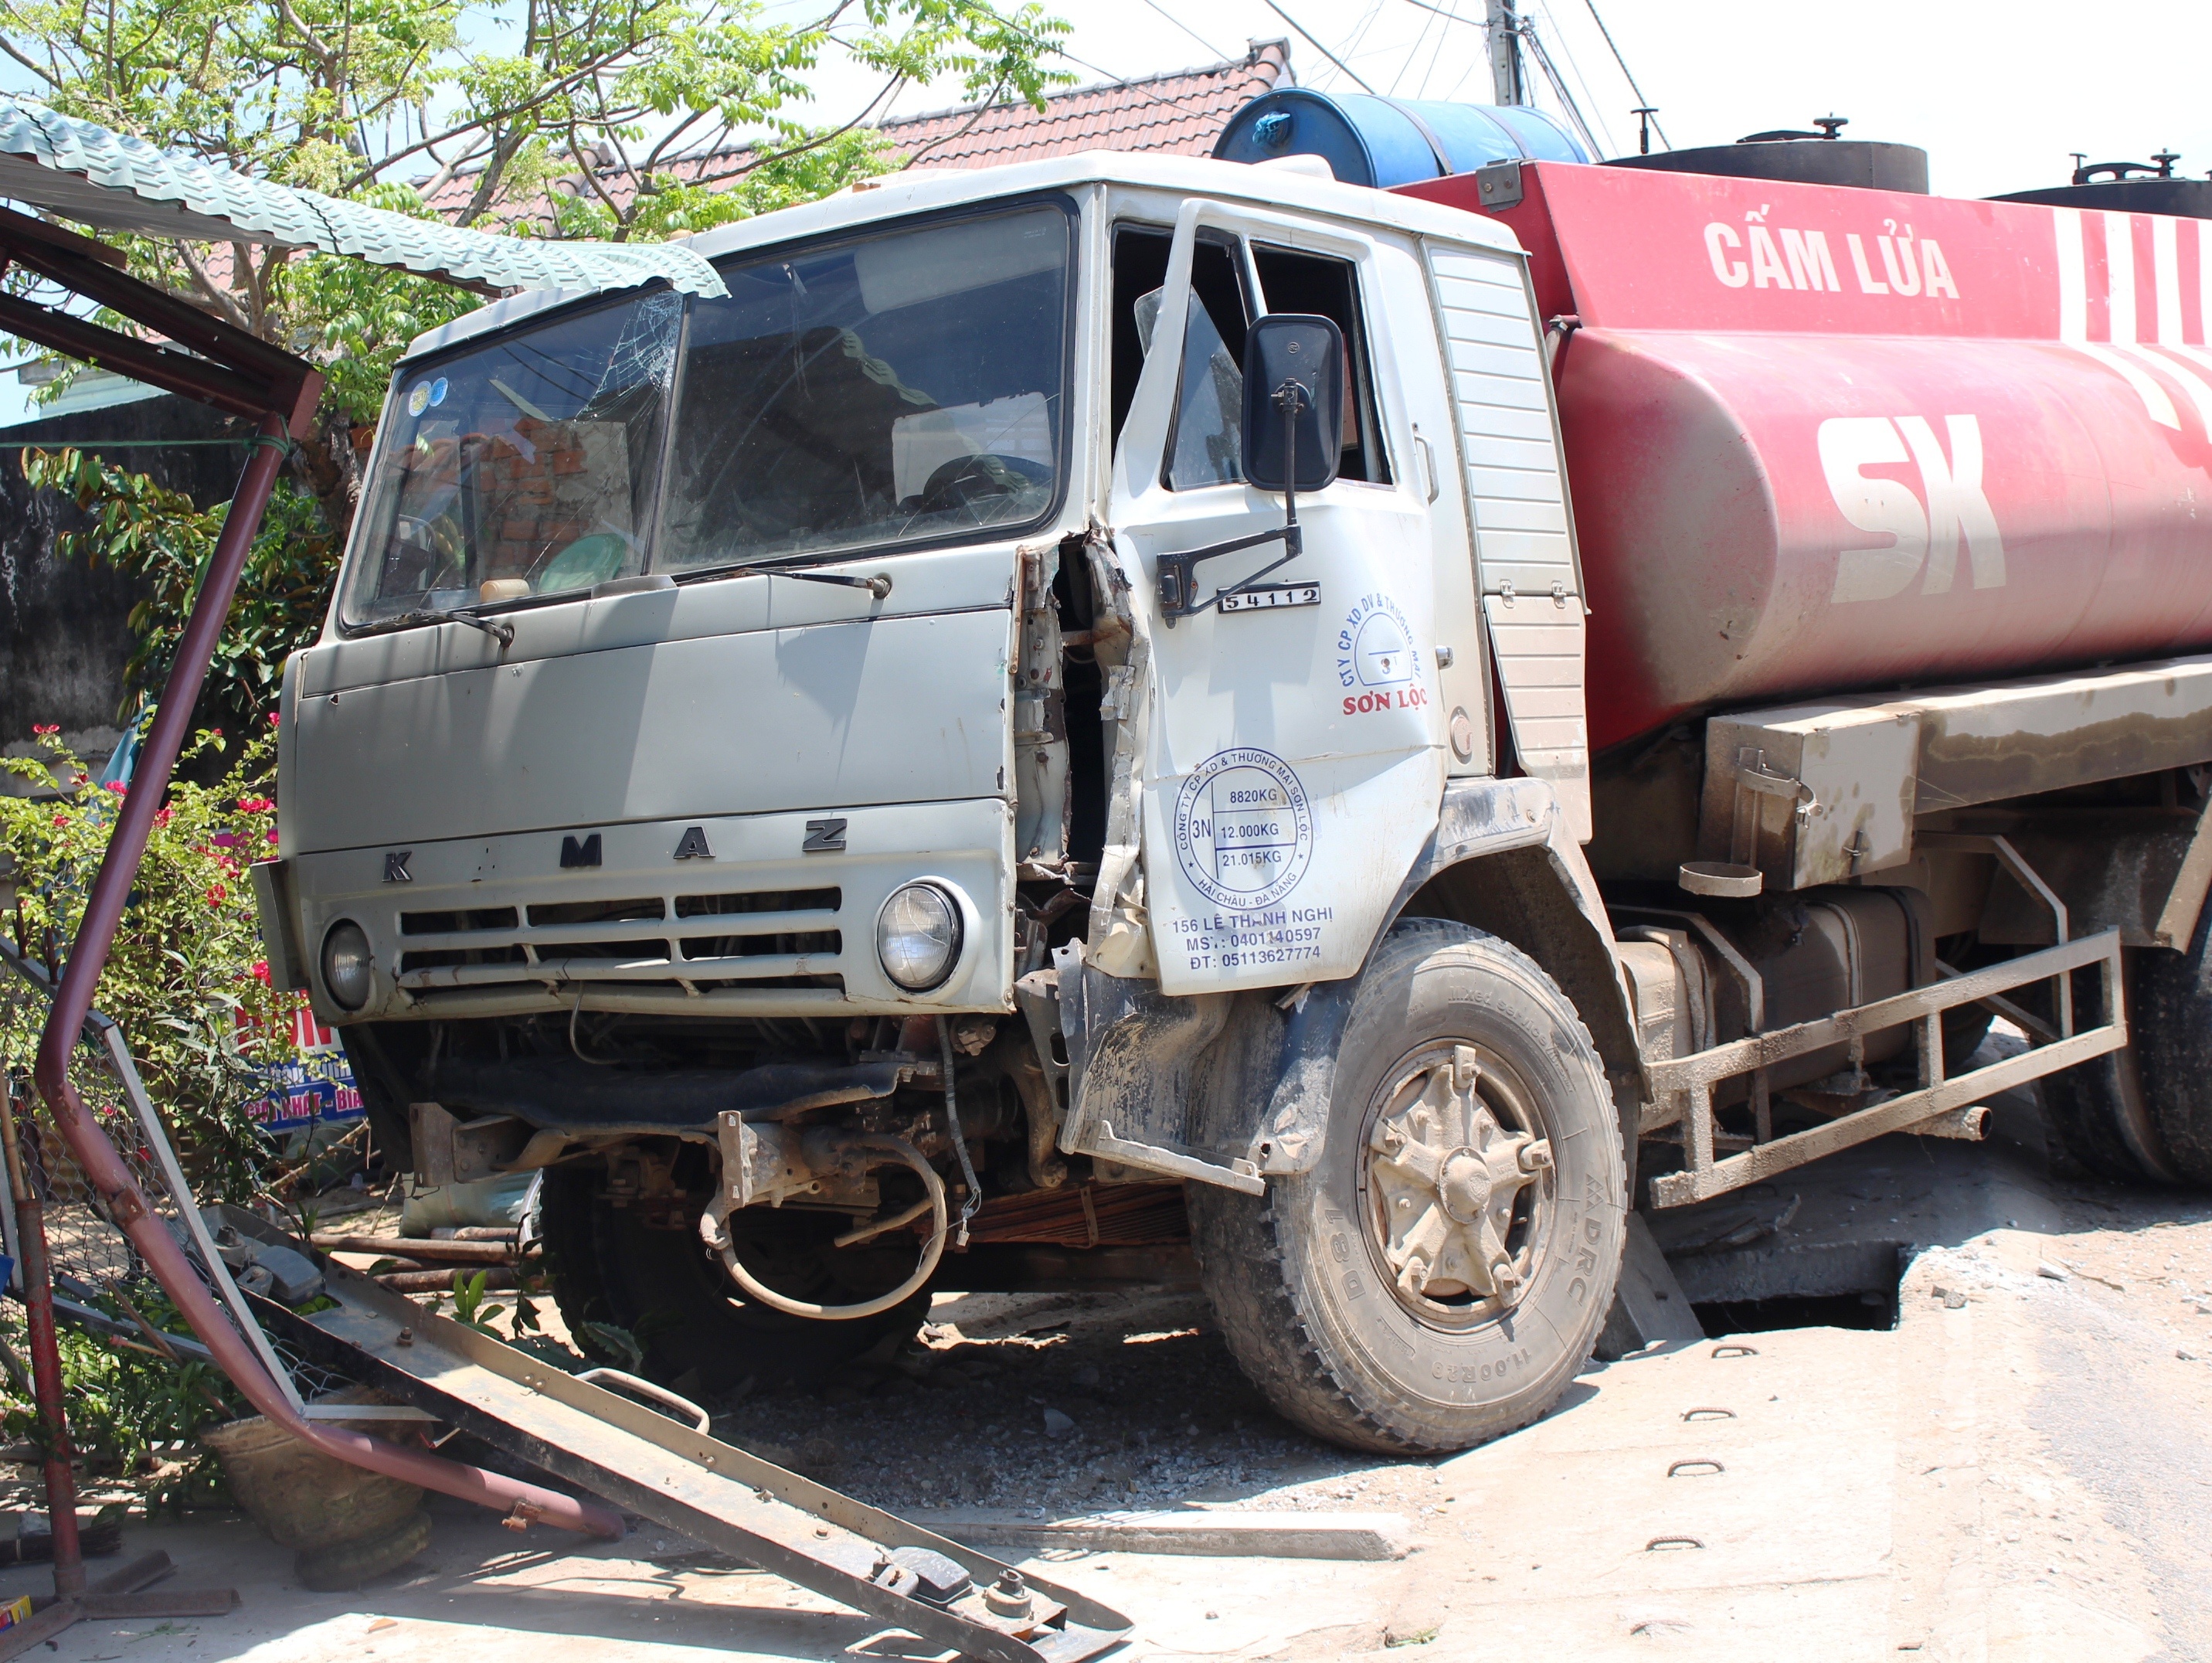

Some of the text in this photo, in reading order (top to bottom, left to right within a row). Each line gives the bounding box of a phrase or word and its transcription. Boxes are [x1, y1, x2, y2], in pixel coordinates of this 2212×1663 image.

[1704, 204, 1960, 299] CẤM LỬA
[1817, 414, 2006, 604] SK
[1225, 589, 1317, 609] 54112
[1361, 593, 1374, 612] DV
[1346, 607, 1362, 629] XD
[1337, 630, 1353, 651] CP
[1337, 658, 1355, 687] CTY
[1343, 682, 1427, 716] SƠN LỘC
[1177, 752, 1311, 850] CÔNG TY CP XD & THƯƠNG MẠI SƠN LỘC
[1230, 788, 1278, 804] 8820KG
[1192, 819, 1211, 839] 3N
[1221, 823, 1279, 839] 12.000KG
[1222, 851, 1282, 867] 21.015KG
[1217, 893, 1246, 907] CHÂU
[1173, 919, 1198, 933] 156
[1204, 913, 1223, 931] LÊ
[1292, 906, 1333, 923] NGHỊ
[1231, 927, 1321, 947] 0401140597
[1191, 945, 1321, 970] ĐT: 05113627774
[1567, 1218, 1602, 1307] DRC
